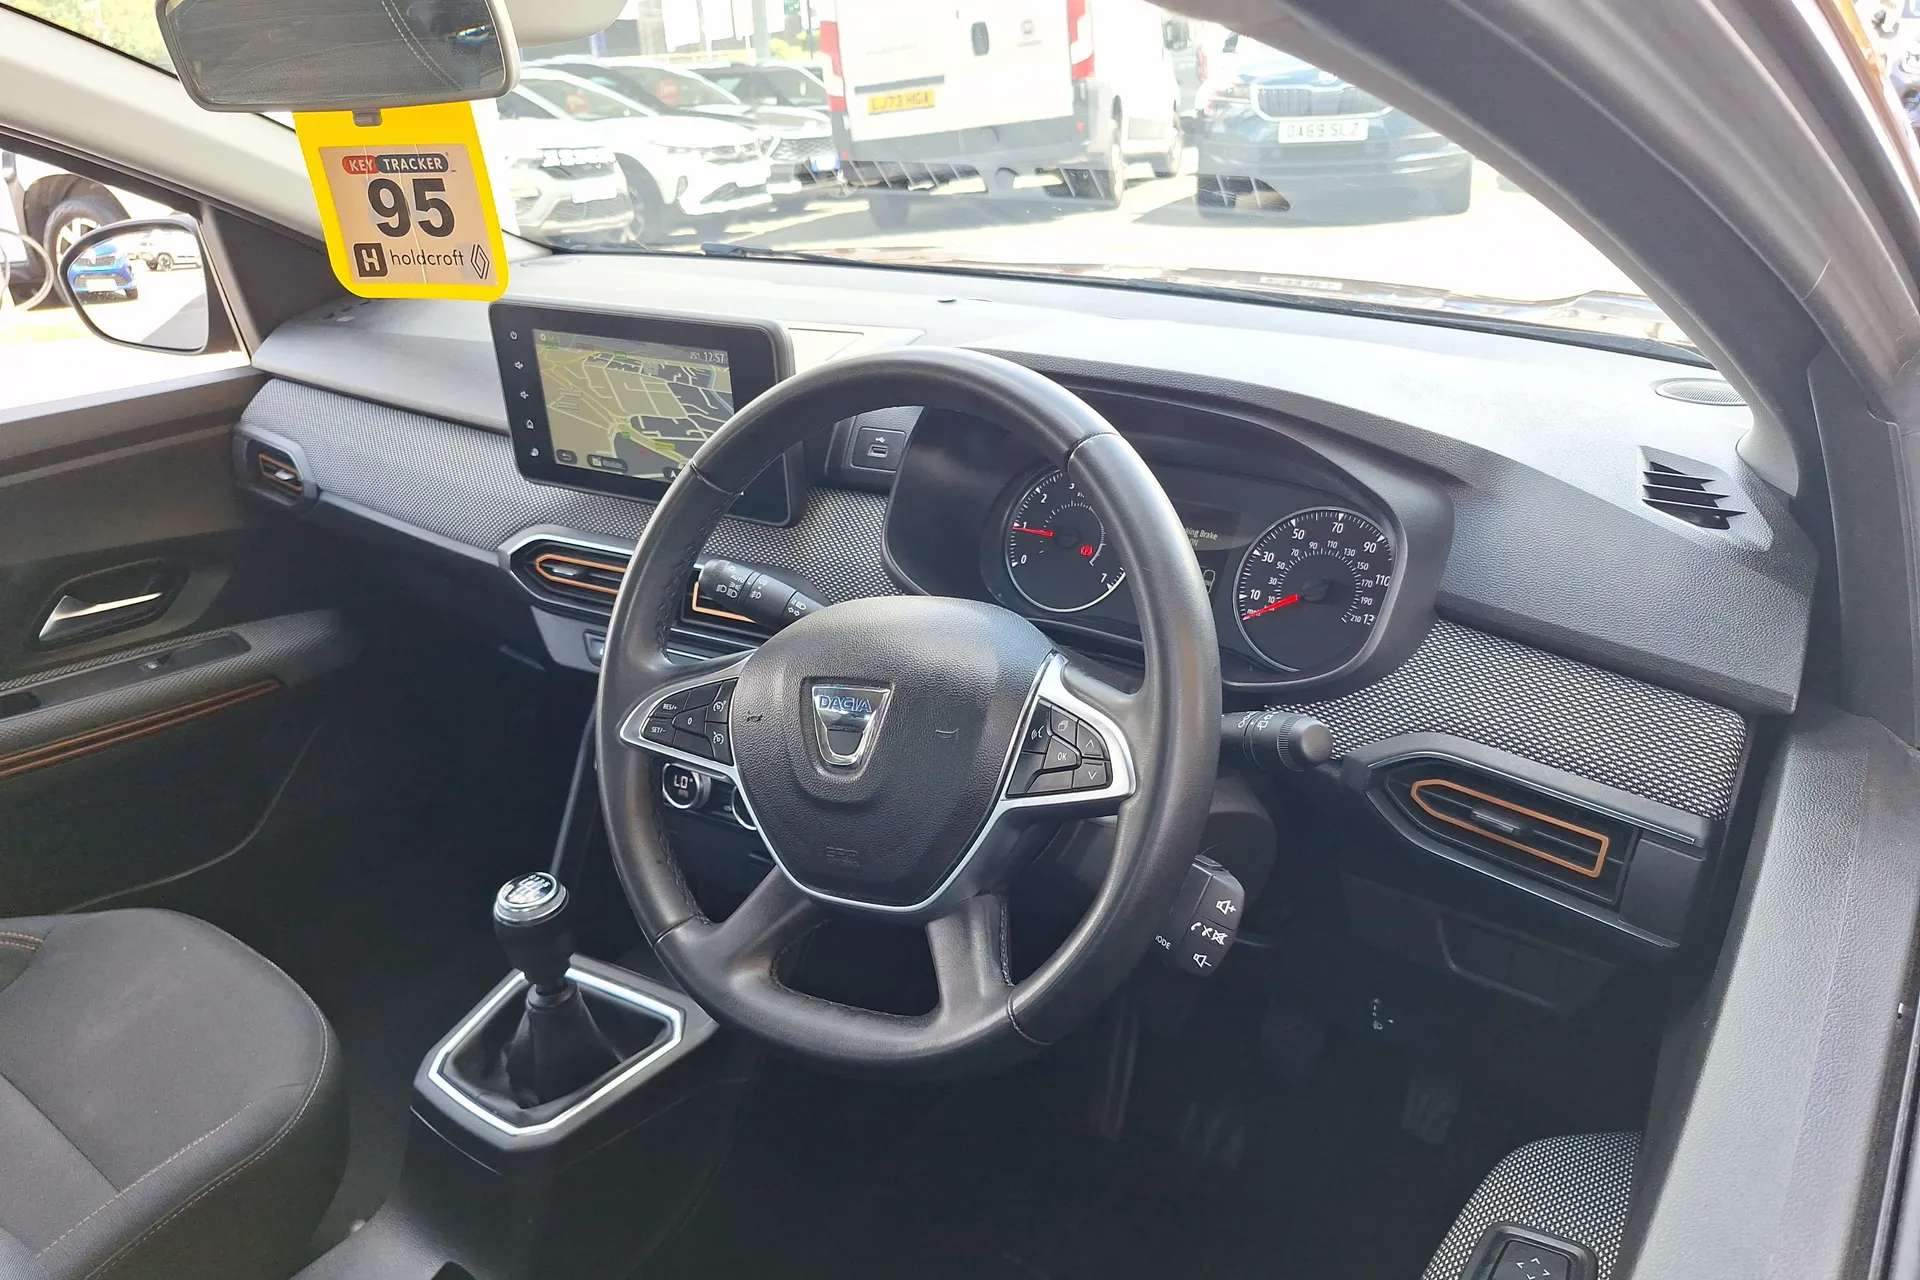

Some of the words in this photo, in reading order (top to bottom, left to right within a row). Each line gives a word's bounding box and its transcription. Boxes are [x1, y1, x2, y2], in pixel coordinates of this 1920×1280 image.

[348, 159, 374, 172] KEY
[382, 157, 443, 171] TRACKER
[367, 178, 455, 237] 95
[389, 249, 464, 266] holdcroft
[1041, 494, 1047, 503] 2
[1331, 521, 1344, 533] 70
[1200, 529, 1218, 540] Brake
[1292, 528, 1305, 540] 50
[1308, 541, 1318, 549] 90
[1327, 540, 1337, 549] 110
[1363, 541, 1376, 553] 90
[1262, 551, 1274, 563] 30
[1291, 548, 1299, 557] 70
[1344, 548, 1355, 557] 130
[1021, 555, 1027, 564] 0
[1276, 561, 1285, 570] 50
[1357, 562, 1368, 570] 150
[1101, 573, 1107, 583] 7
[1268, 577, 1277, 585] 30
[1361, 579, 1373, 588] 170
[1250, 589, 1261, 600] 10
[1268, 595, 1275, 603] 10
[1361, 596, 1373, 605] 190
[1350, 614, 1361, 623] 210
[819, 695, 872, 712] DACIA
[1057, 752, 1067, 761] OK
